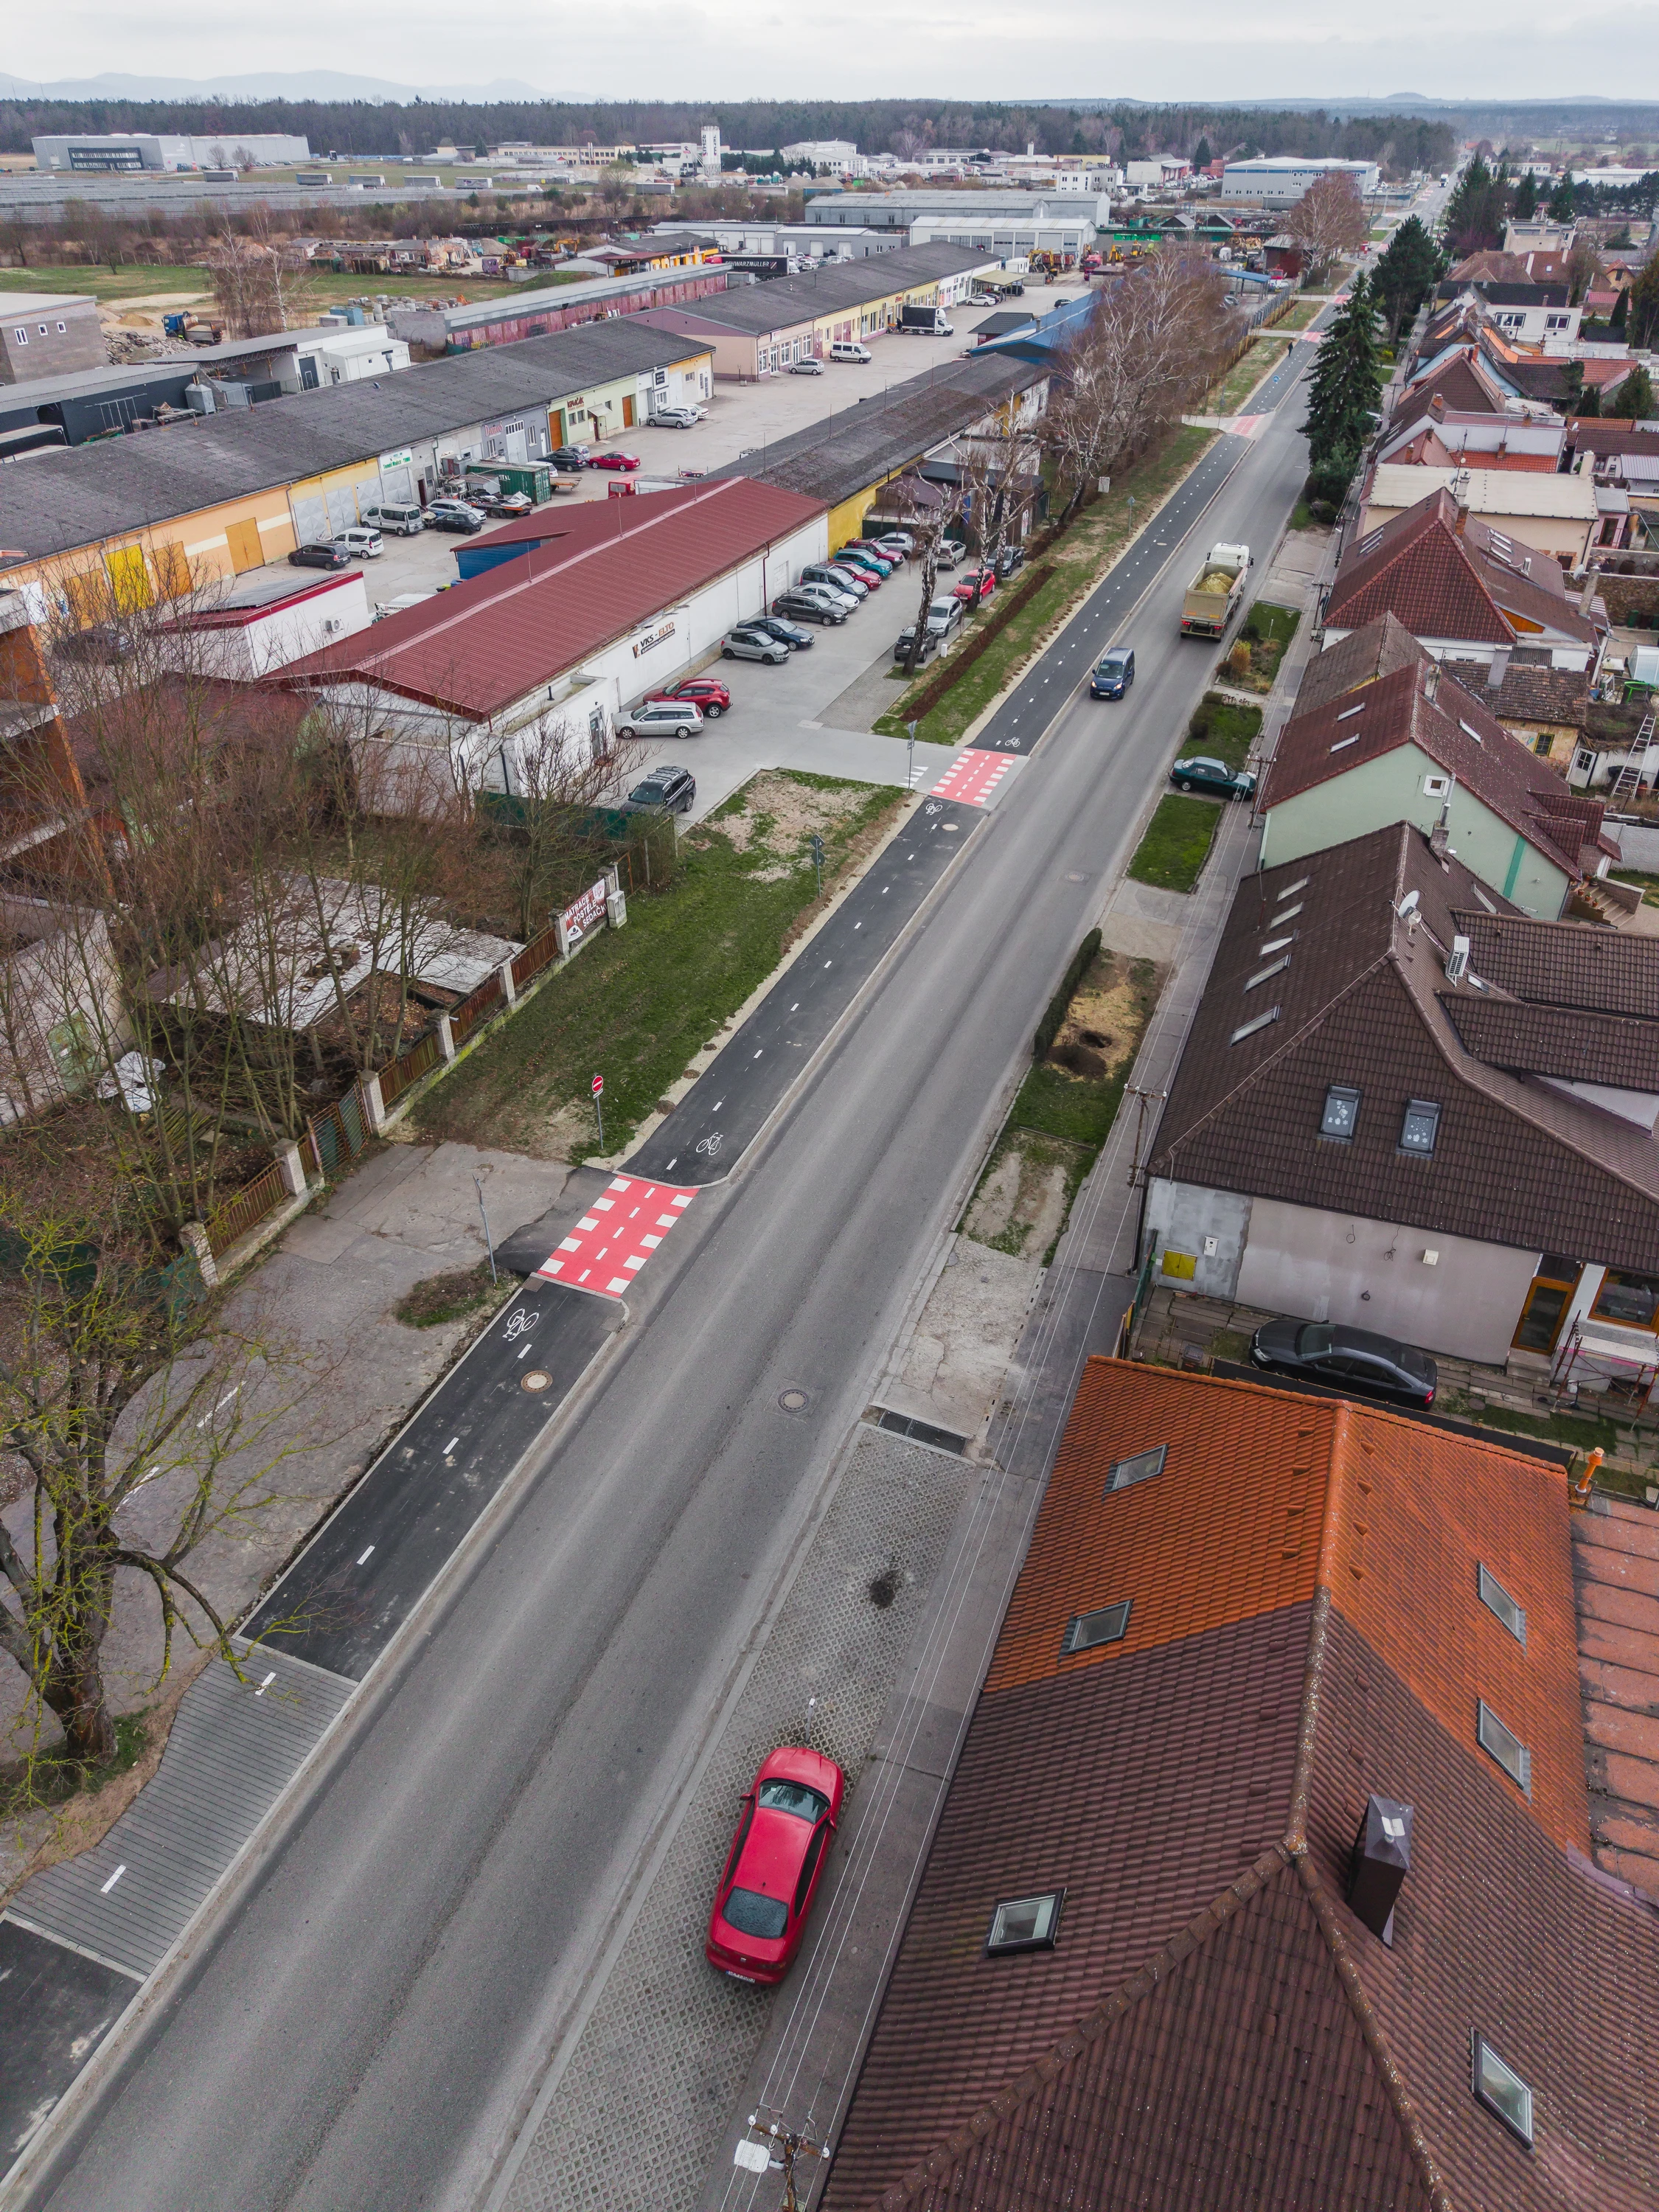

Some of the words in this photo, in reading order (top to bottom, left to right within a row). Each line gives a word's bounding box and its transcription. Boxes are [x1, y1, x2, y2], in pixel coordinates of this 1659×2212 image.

[640, 634, 654, 647] VKS
[658, 622, 674, 636] ELTO
[565, 894, 590, 922] MATRACE
[573, 900, 597, 925] POSTELE
